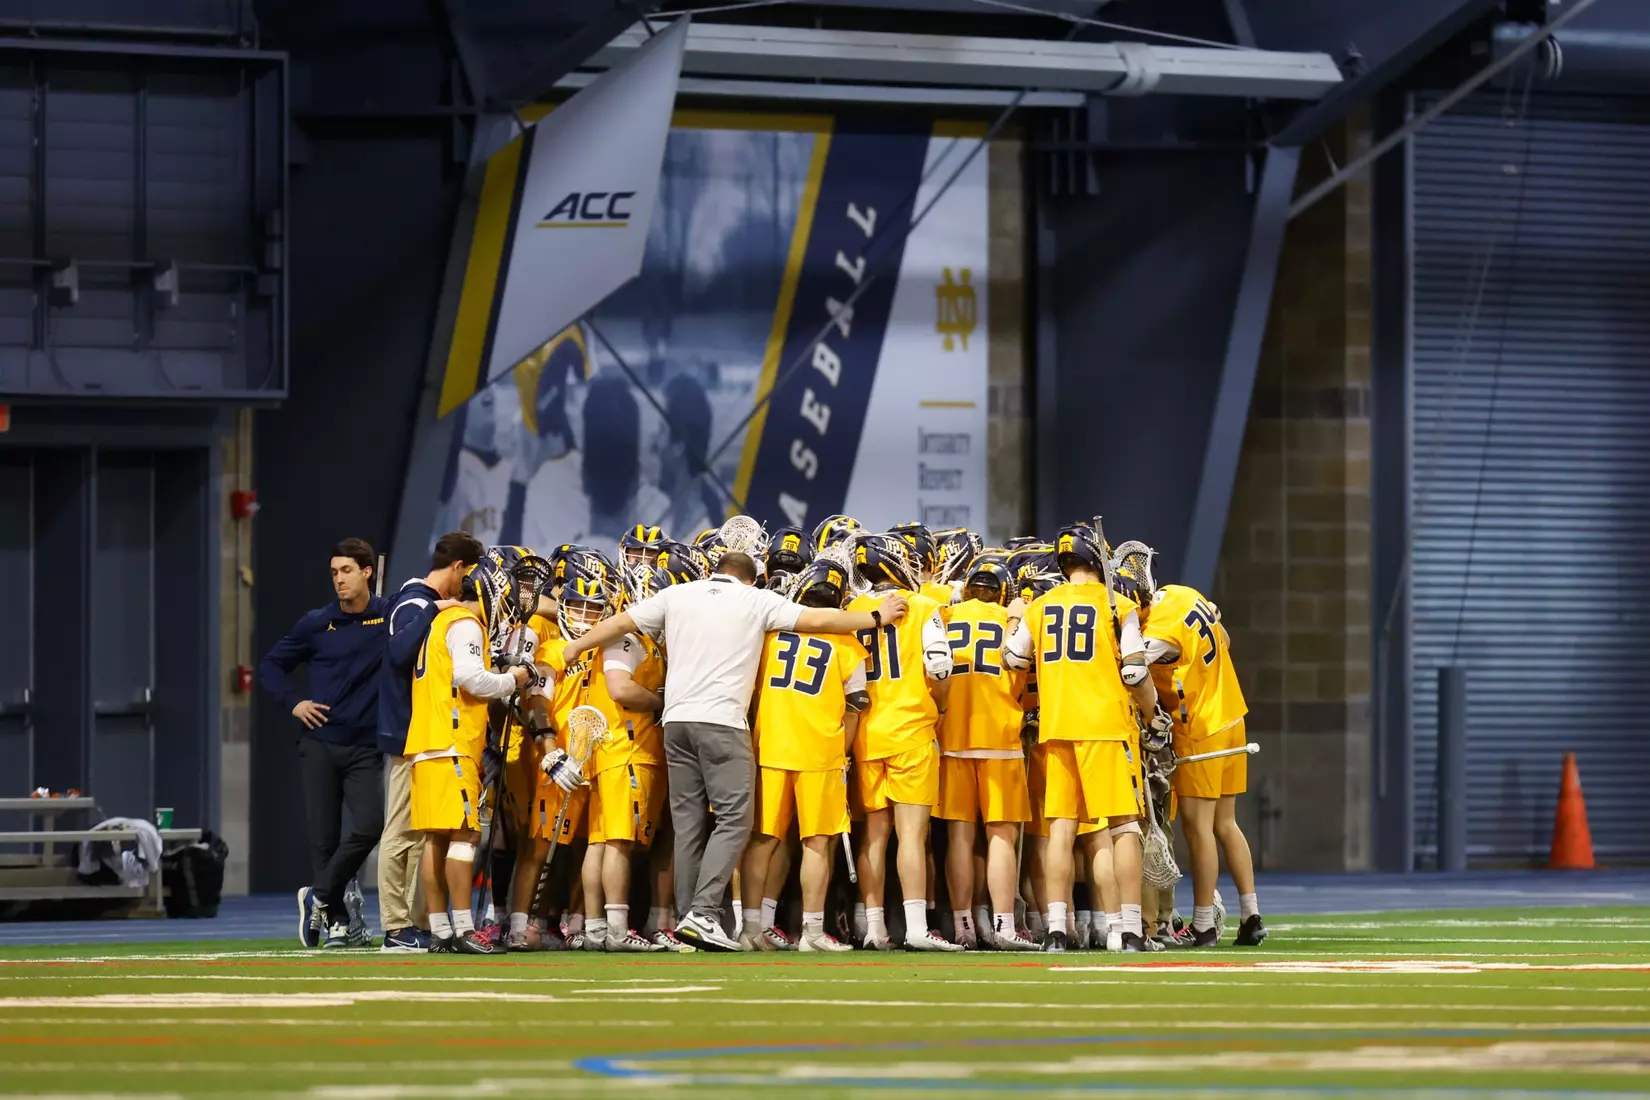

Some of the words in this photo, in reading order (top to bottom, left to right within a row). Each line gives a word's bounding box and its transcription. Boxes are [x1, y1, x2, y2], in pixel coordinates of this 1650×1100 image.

[542, 191, 637, 220] ACC
[469, 643, 481, 657] 30
[623, 640, 631, 652] 2
[947, 622, 1004, 676] 22
[1043, 605, 1097, 662] 38
[770, 631, 833, 696] 33
